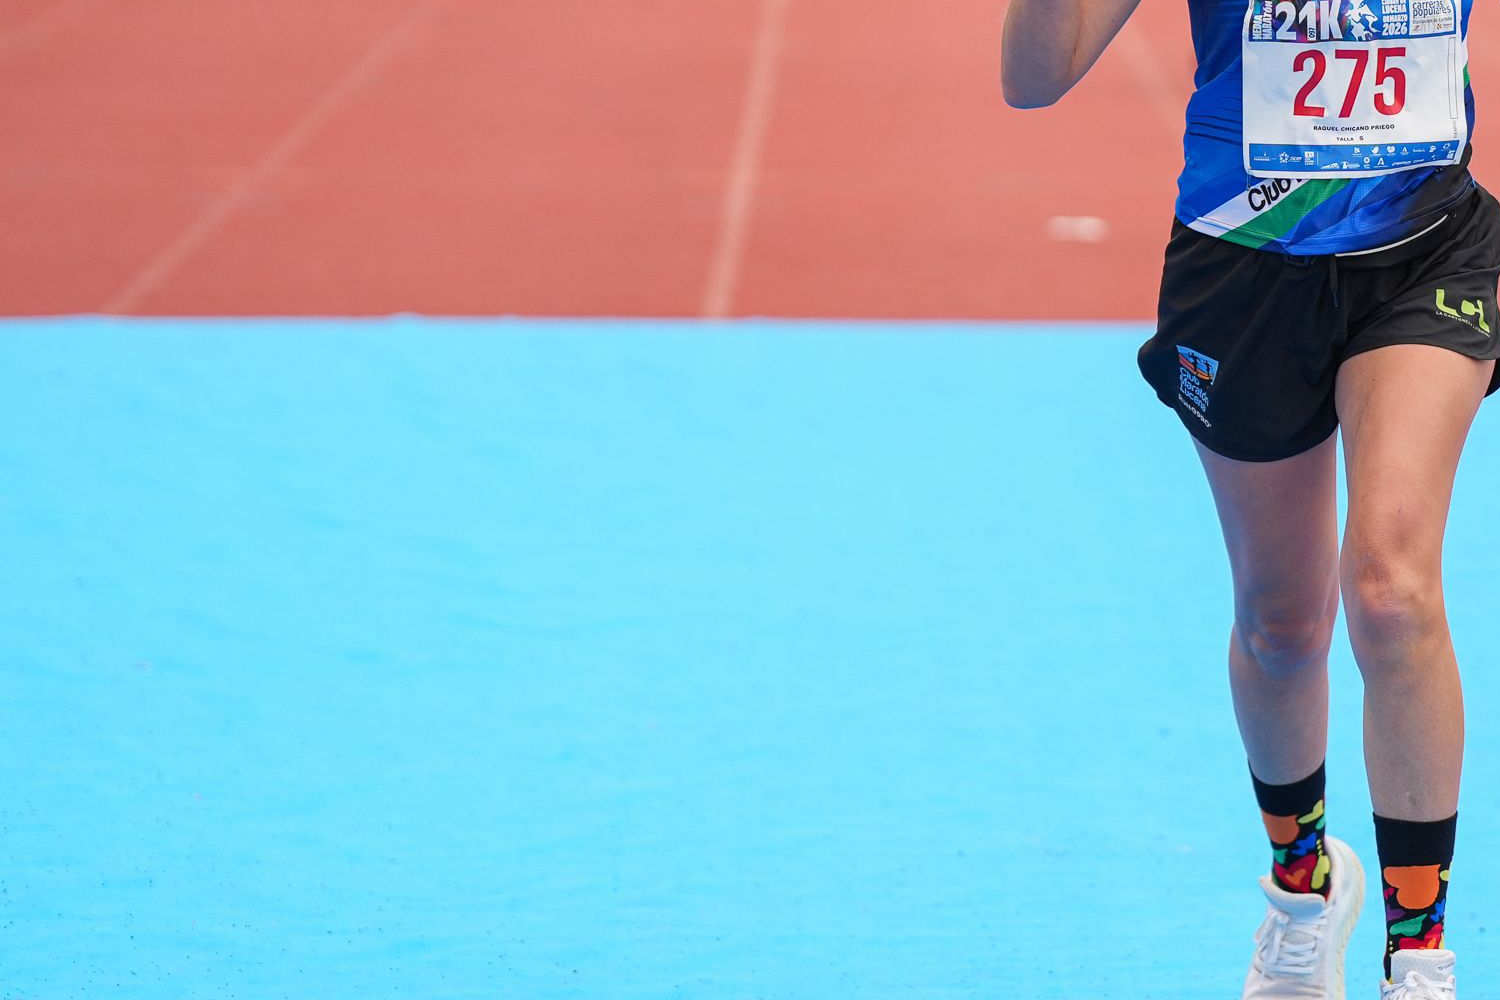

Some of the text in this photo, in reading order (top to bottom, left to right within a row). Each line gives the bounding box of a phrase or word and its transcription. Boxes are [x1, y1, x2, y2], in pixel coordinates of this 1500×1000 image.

[1382, 4, 1407, 14] LUCENA
[1413, 0, 1443, 10] carreras
[1413, 5, 1451, 18] populares
[1275, 0, 1343, 41] 21K
[1382, 22, 1408, 36] 2026
[1292, 47, 1407, 119] 275
[1248, 178, 1292, 212] Club
[1179, 366, 1200, 386] Club
[1179, 374, 1209, 407] Maratón
[1179, 381, 1206, 413] Lucena
